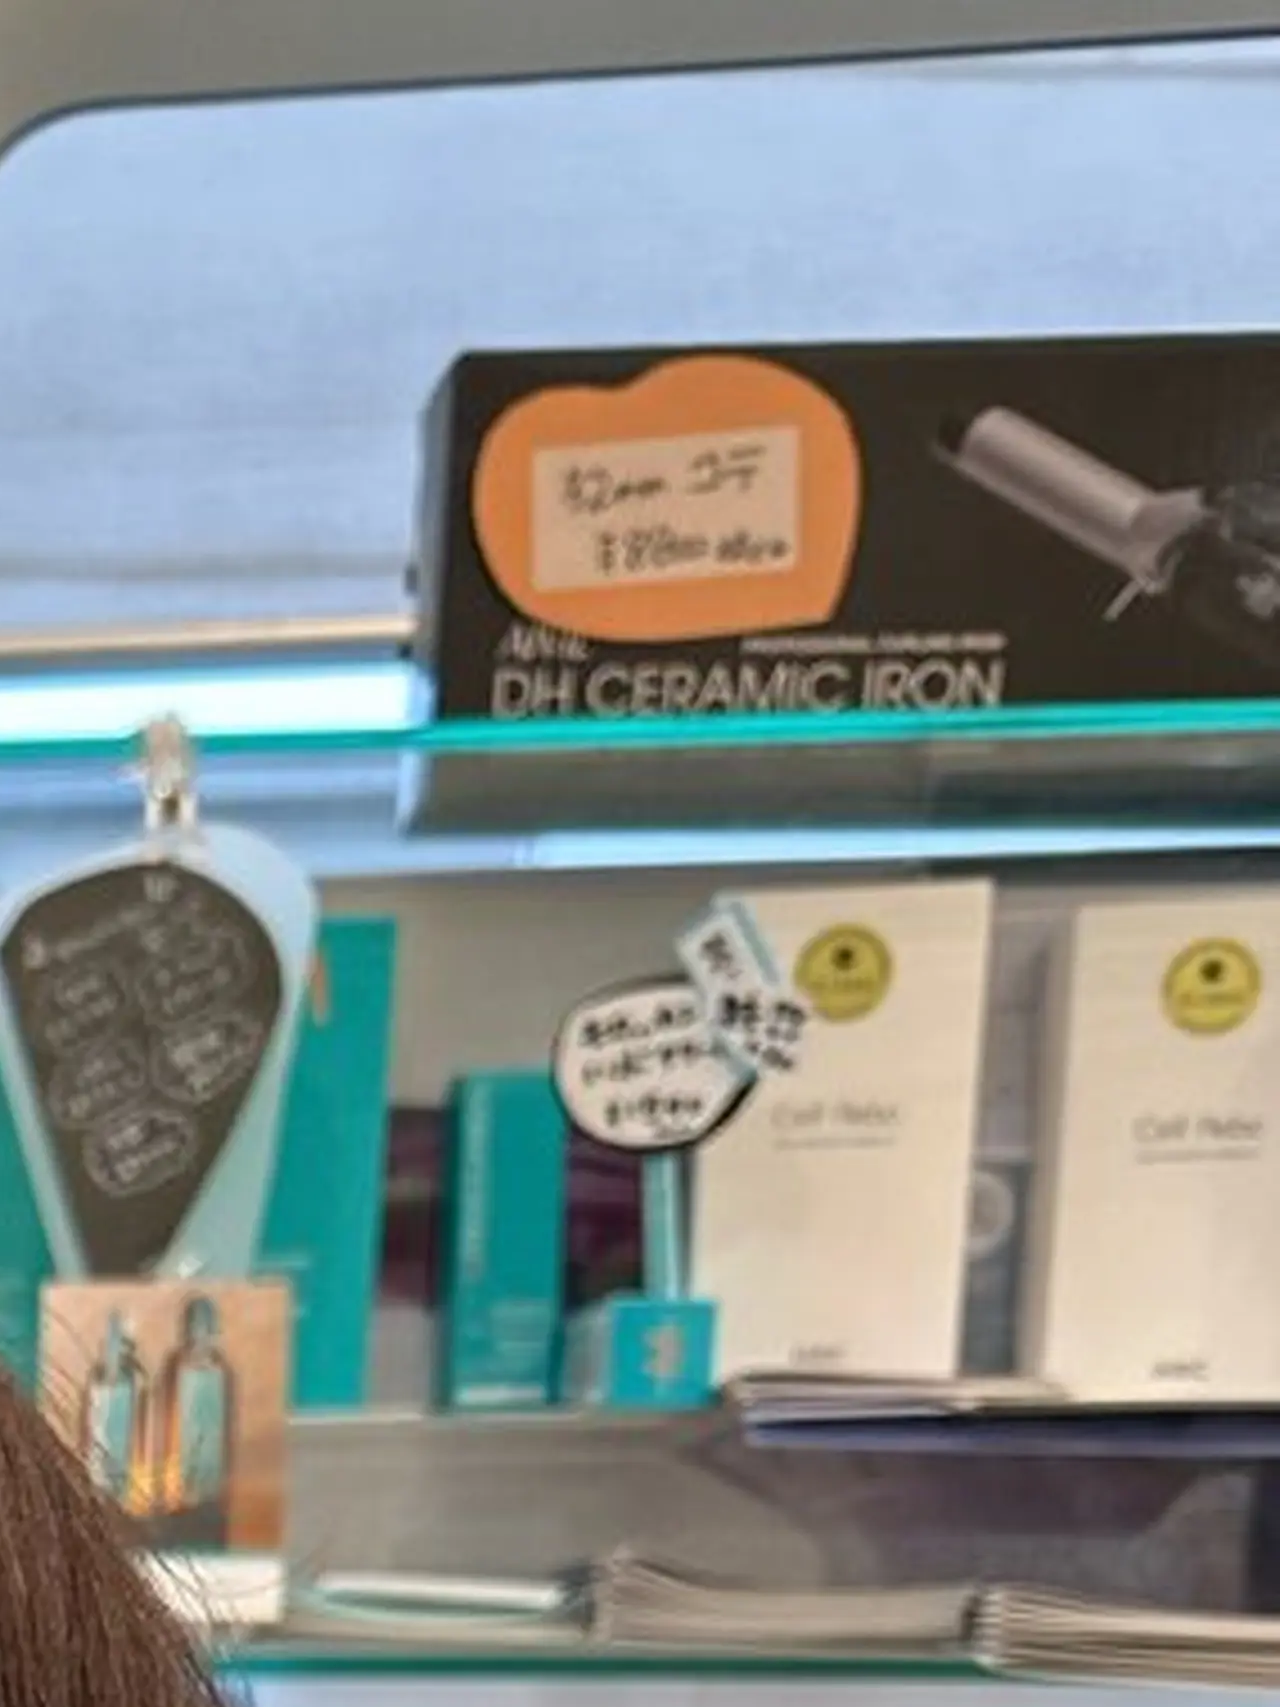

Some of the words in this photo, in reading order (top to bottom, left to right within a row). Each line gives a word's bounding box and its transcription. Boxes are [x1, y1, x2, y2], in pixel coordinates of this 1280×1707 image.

[492, 668, 573, 718] DH
[585, 662, 848, 718] CERAMIC
[864, 655, 1004, 710] IRON
